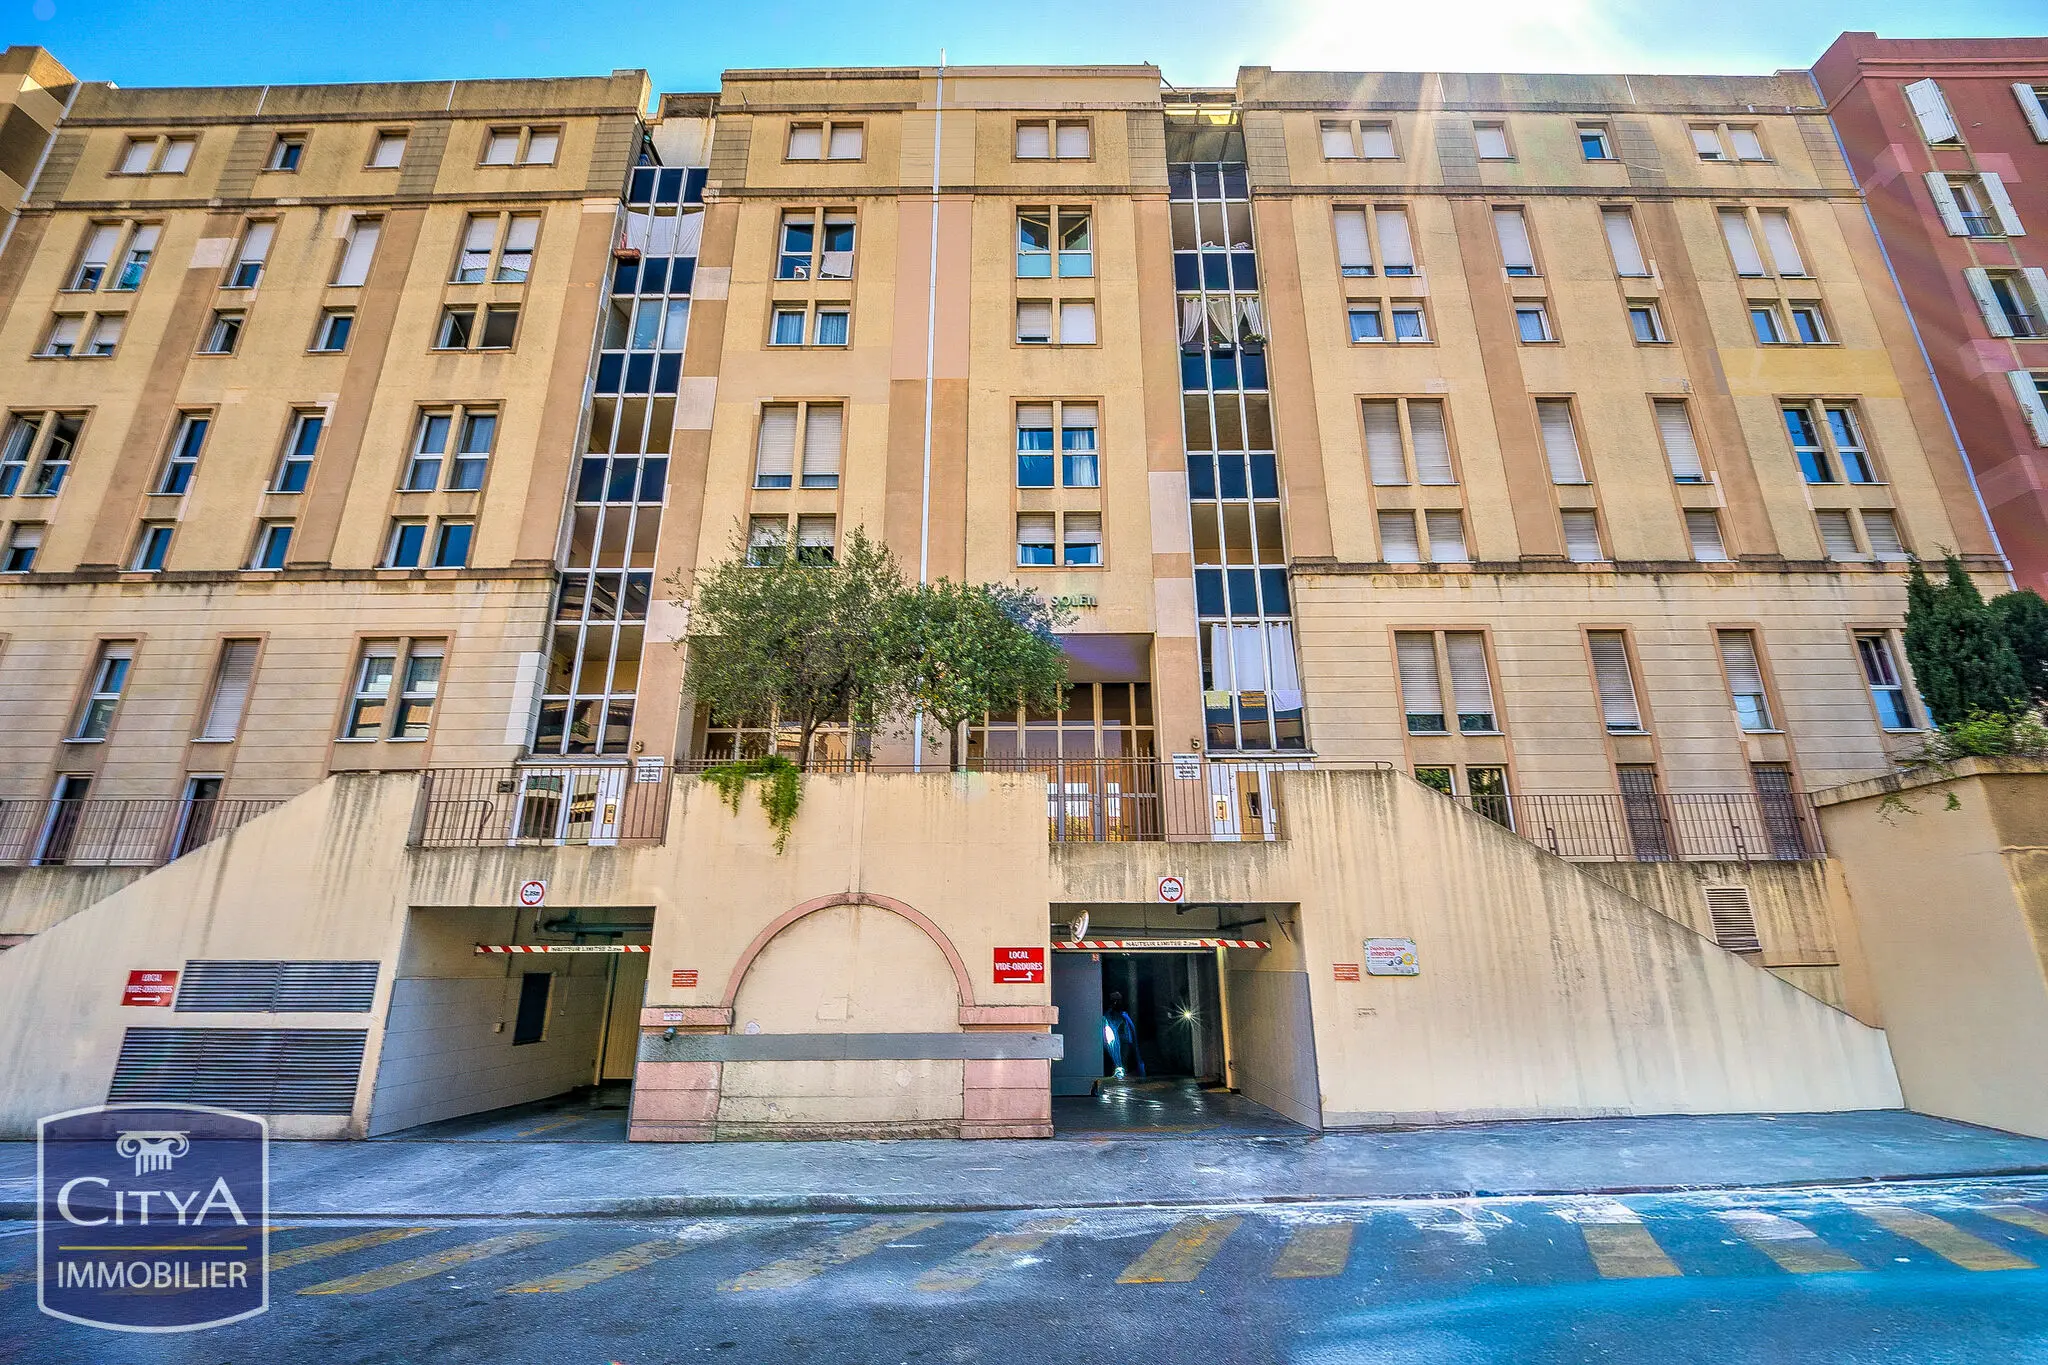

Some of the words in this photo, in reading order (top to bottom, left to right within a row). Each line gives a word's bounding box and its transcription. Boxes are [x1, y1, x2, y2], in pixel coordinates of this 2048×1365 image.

[1050, 594, 1098, 608] SOLEIL
[633, 739, 644, 753] 3
[1190, 737, 1201, 750] 5
[1008, 950, 1029, 960] LOCAL
[994, 962, 1043, 972] VIDE-ORDURES
[141, 973, 163, 982] LOCAL
[126, 985, 173, 993] VIDE-ORDURES
